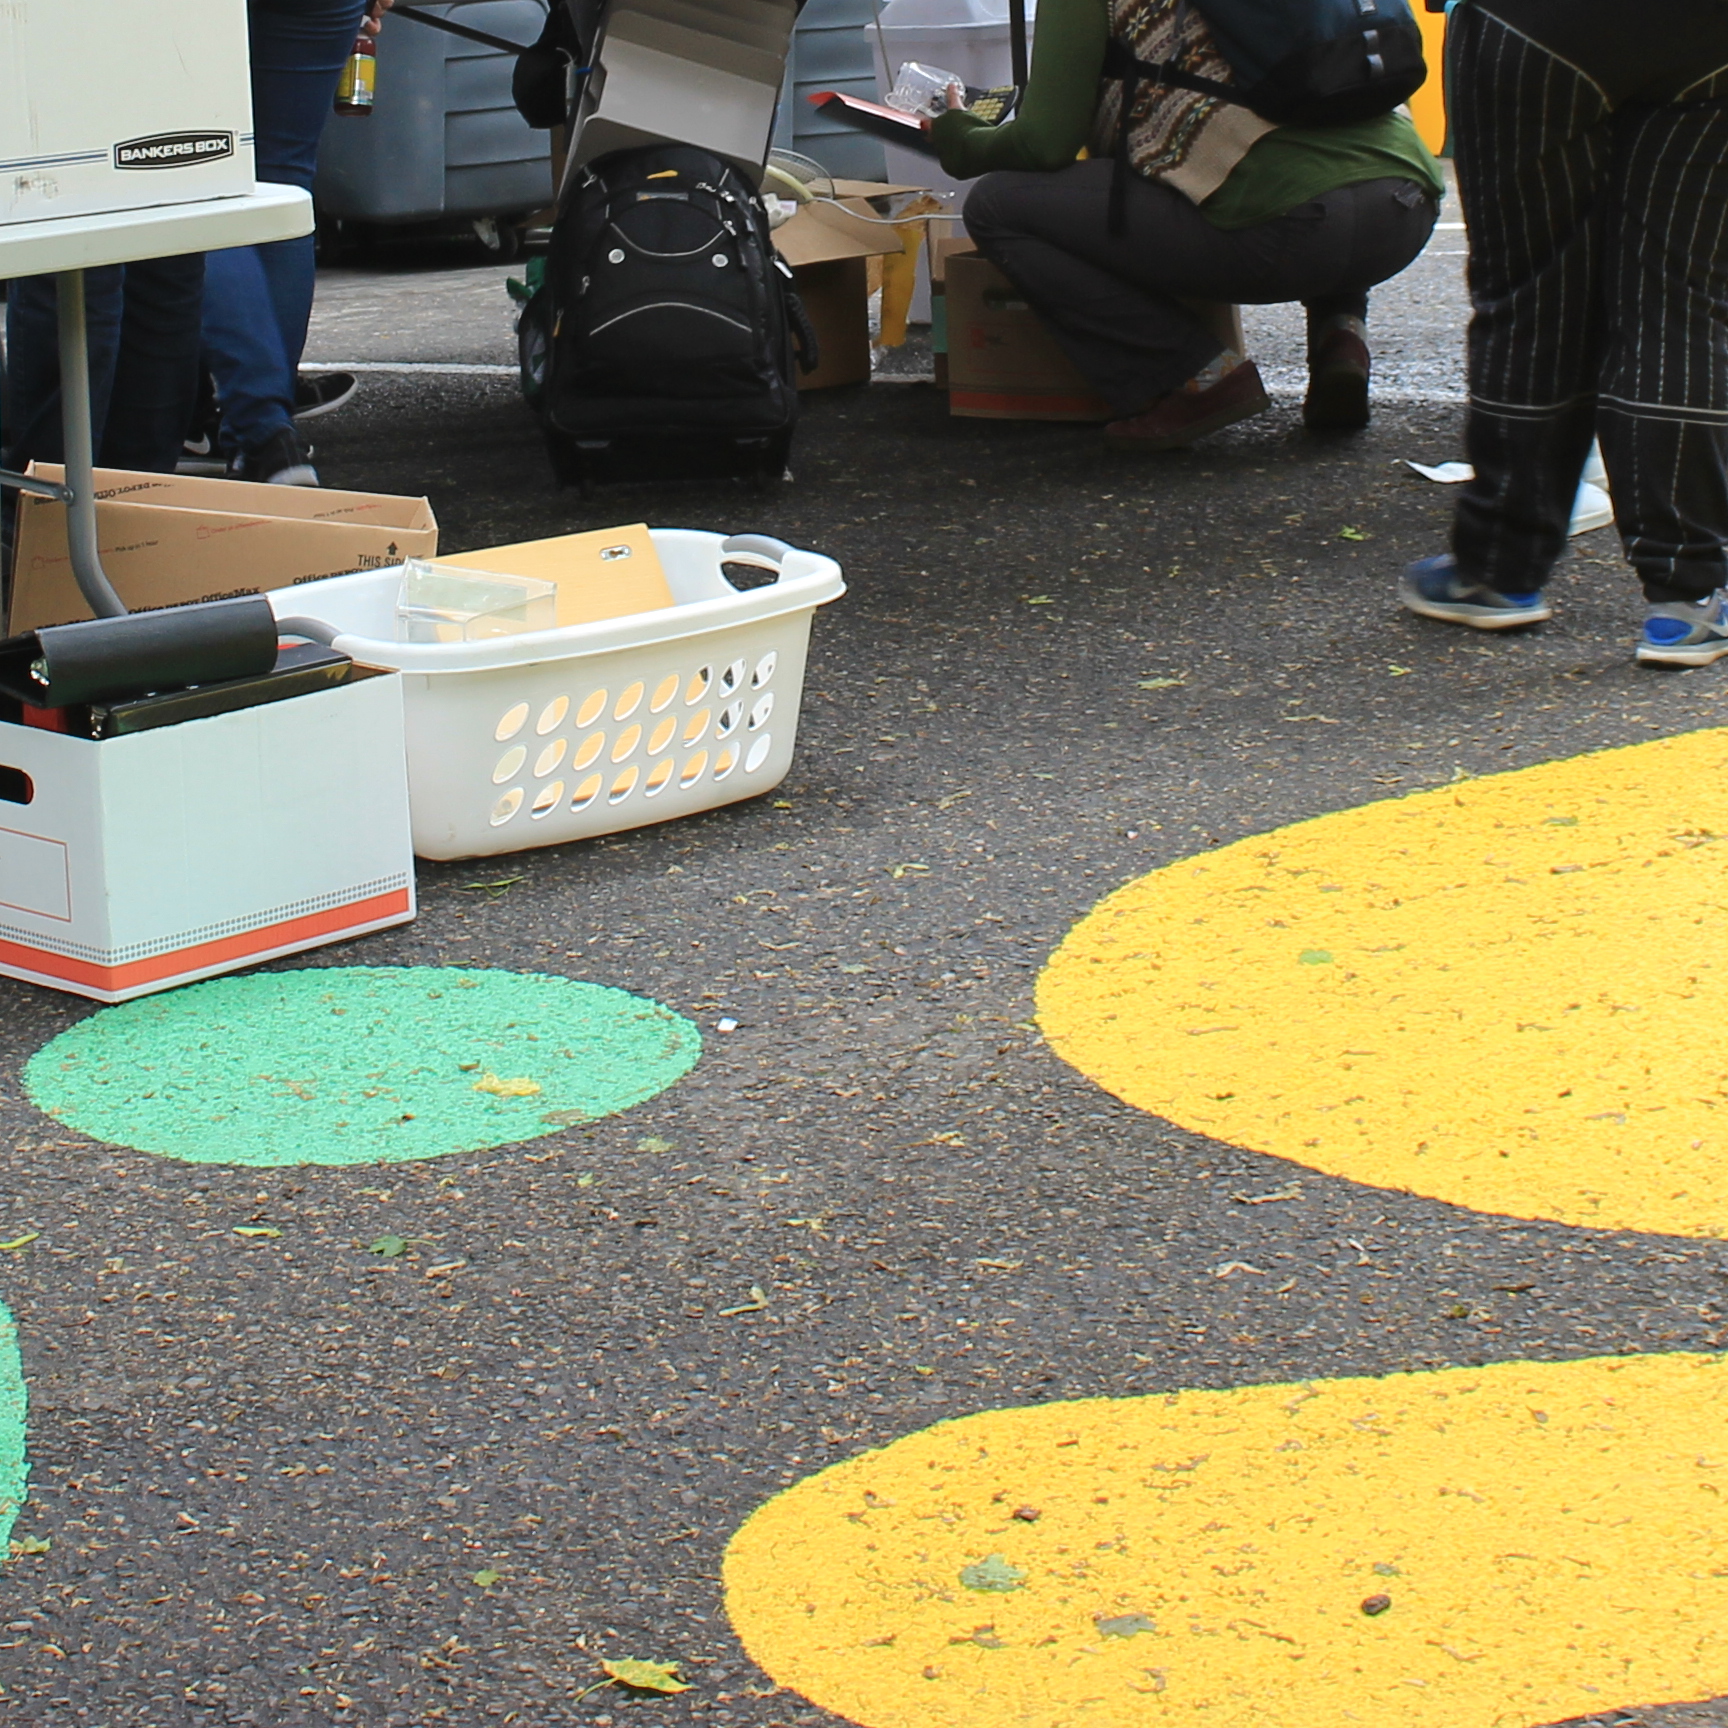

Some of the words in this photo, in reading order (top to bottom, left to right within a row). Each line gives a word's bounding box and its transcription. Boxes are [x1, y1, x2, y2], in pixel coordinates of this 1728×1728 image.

[120, 141, 194, 162] BANKERS
[195, 137, 228, 154] BOX
[358, 554, 381, 568] THIS
[384, 556, 406, 568] SID
